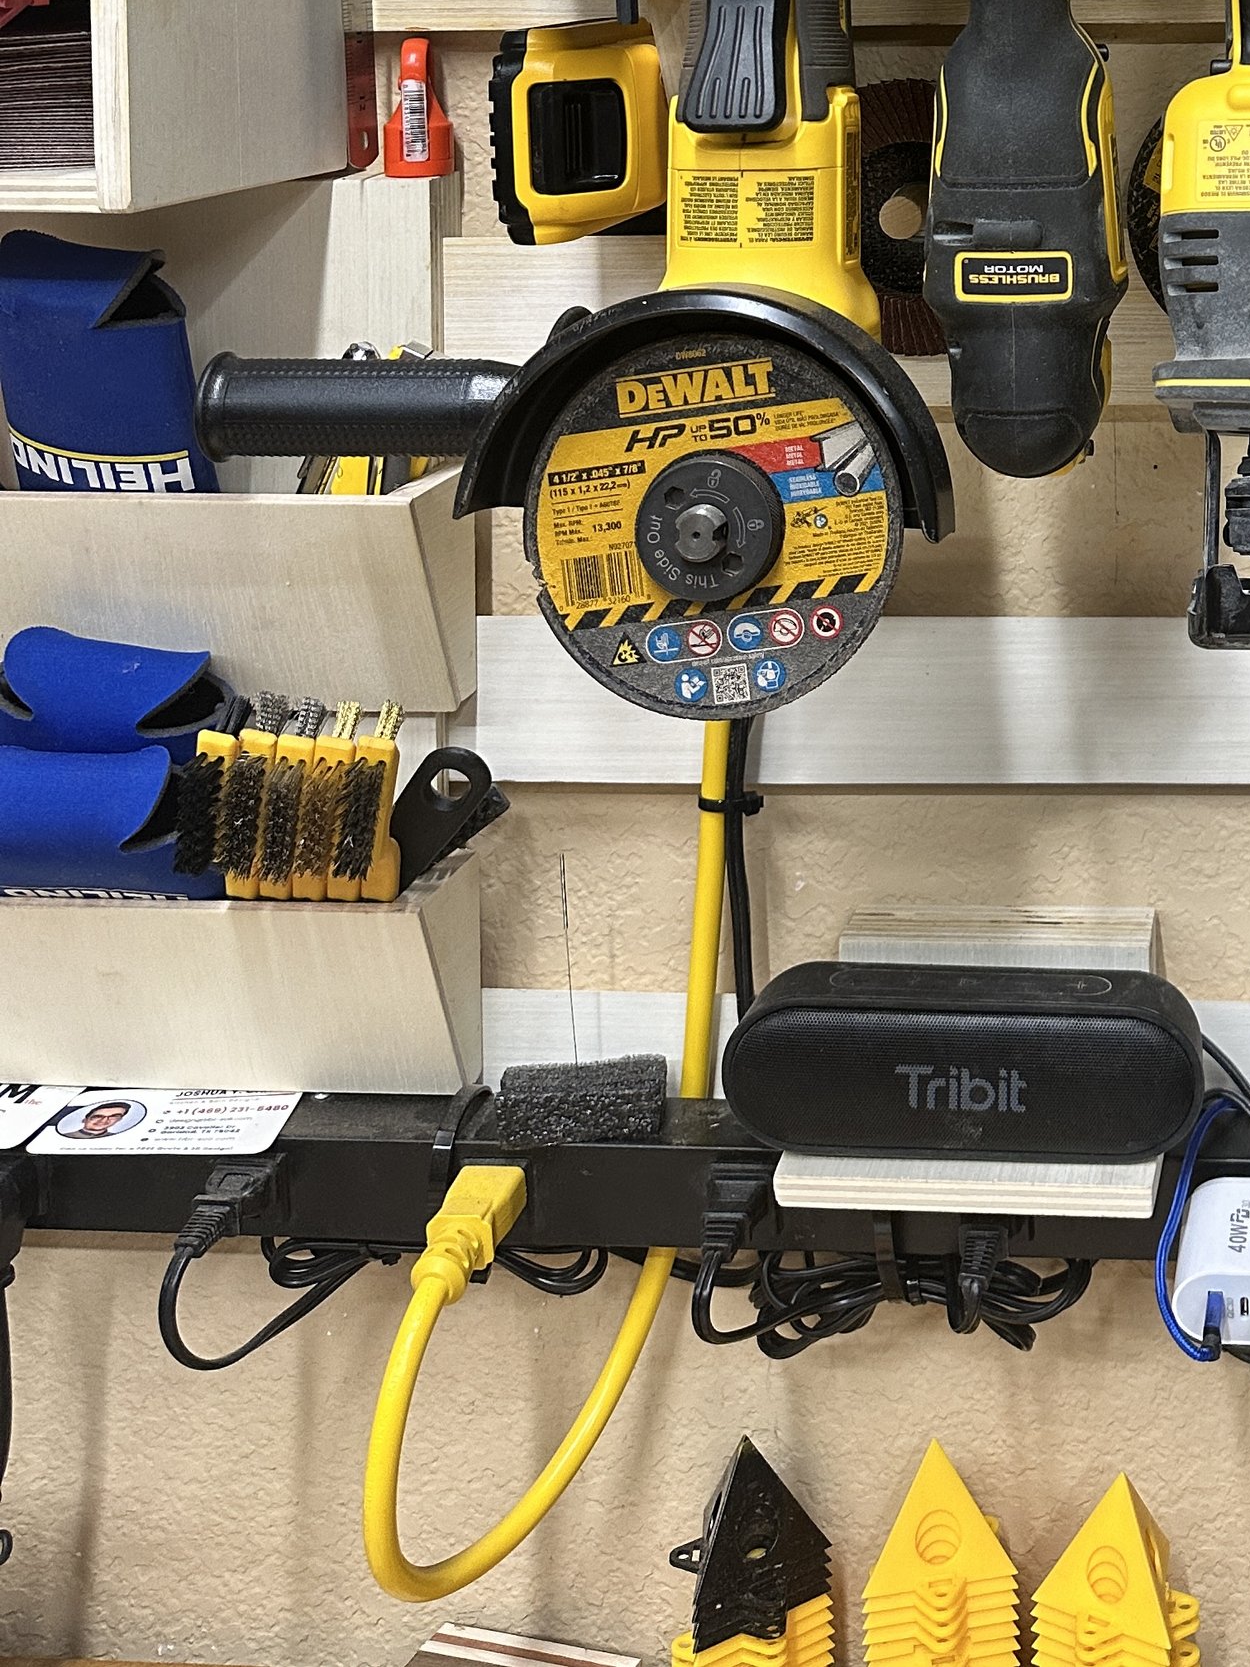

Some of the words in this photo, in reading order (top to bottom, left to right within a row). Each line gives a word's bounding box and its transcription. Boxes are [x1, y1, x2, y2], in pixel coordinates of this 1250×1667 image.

[969, 273, 1061, 285] BRUSHLESS
[984, 265, 1044, 274] MOTOR
[615, 360, 775, 414] DEWALT
[690, 424, 708, 435] UP
[692, 433, 708, 443] TO
[708, 412, 772, 441] 50%
[624, 423, 688, 454] HP
[8, 432, 196, 493] HEILIND
[550, 487, 569, 500] (115
[592, 520, 623, 534] 13,300
[646, 514, 664, 545] Out
[653, 548, 682, 582] Side
[684, 573, 721, 590] This
[894, 1063, 1028, 1113] Tribit
